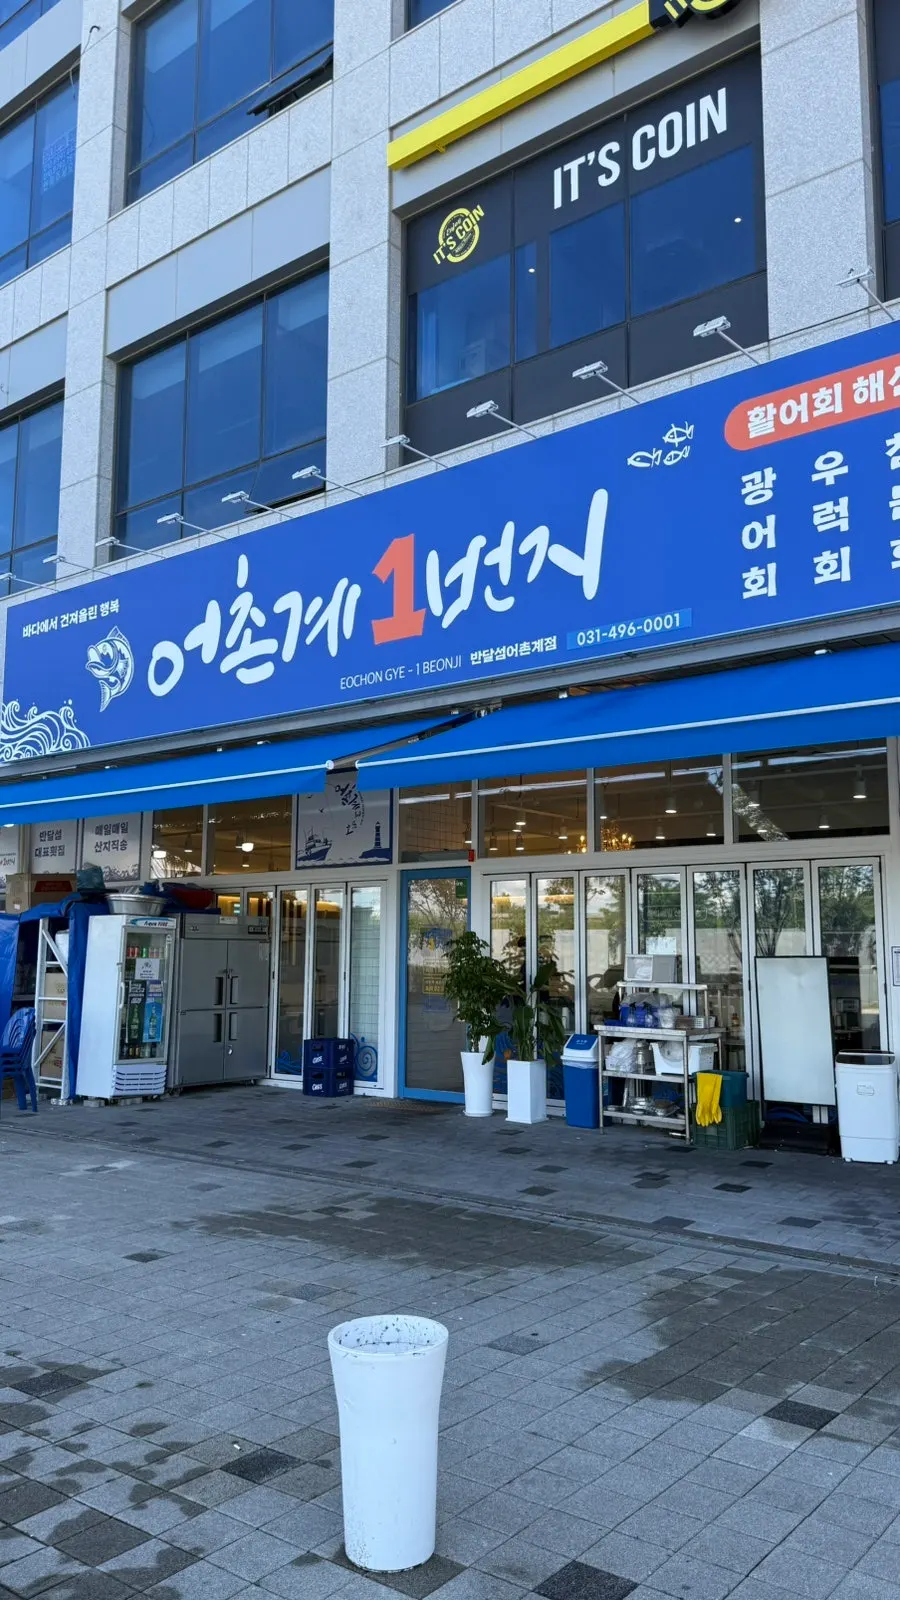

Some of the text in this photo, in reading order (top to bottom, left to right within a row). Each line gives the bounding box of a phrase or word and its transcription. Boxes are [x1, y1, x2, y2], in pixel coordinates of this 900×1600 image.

[554, 87, 727, 210] IT'S COIN
[433, 236, 457, 265] IT'S
[455, 204, 485, 240] COIN
[747, 382, 843, 439] 활어회
[741, 467, 777, 600] 광어회
[811, 450, 851, 585] 우럭회
[147, 488, 609, 697] 어촌계 1번지
[22, 598, 120, 638] 바다에서 건져올린 행복
[576, 612, 681, 646] 031-496-0001
[340, 670, 383, 690] EOCHON
[385, 666, 406, 681] GYE
[422, 655, 462, 674] BEONJI
[470, 635, 557, 666] 반달섬어촌계점
[39, 828, 62, 842] 반달섬
[94, 839, 128, 853] 산지직송
